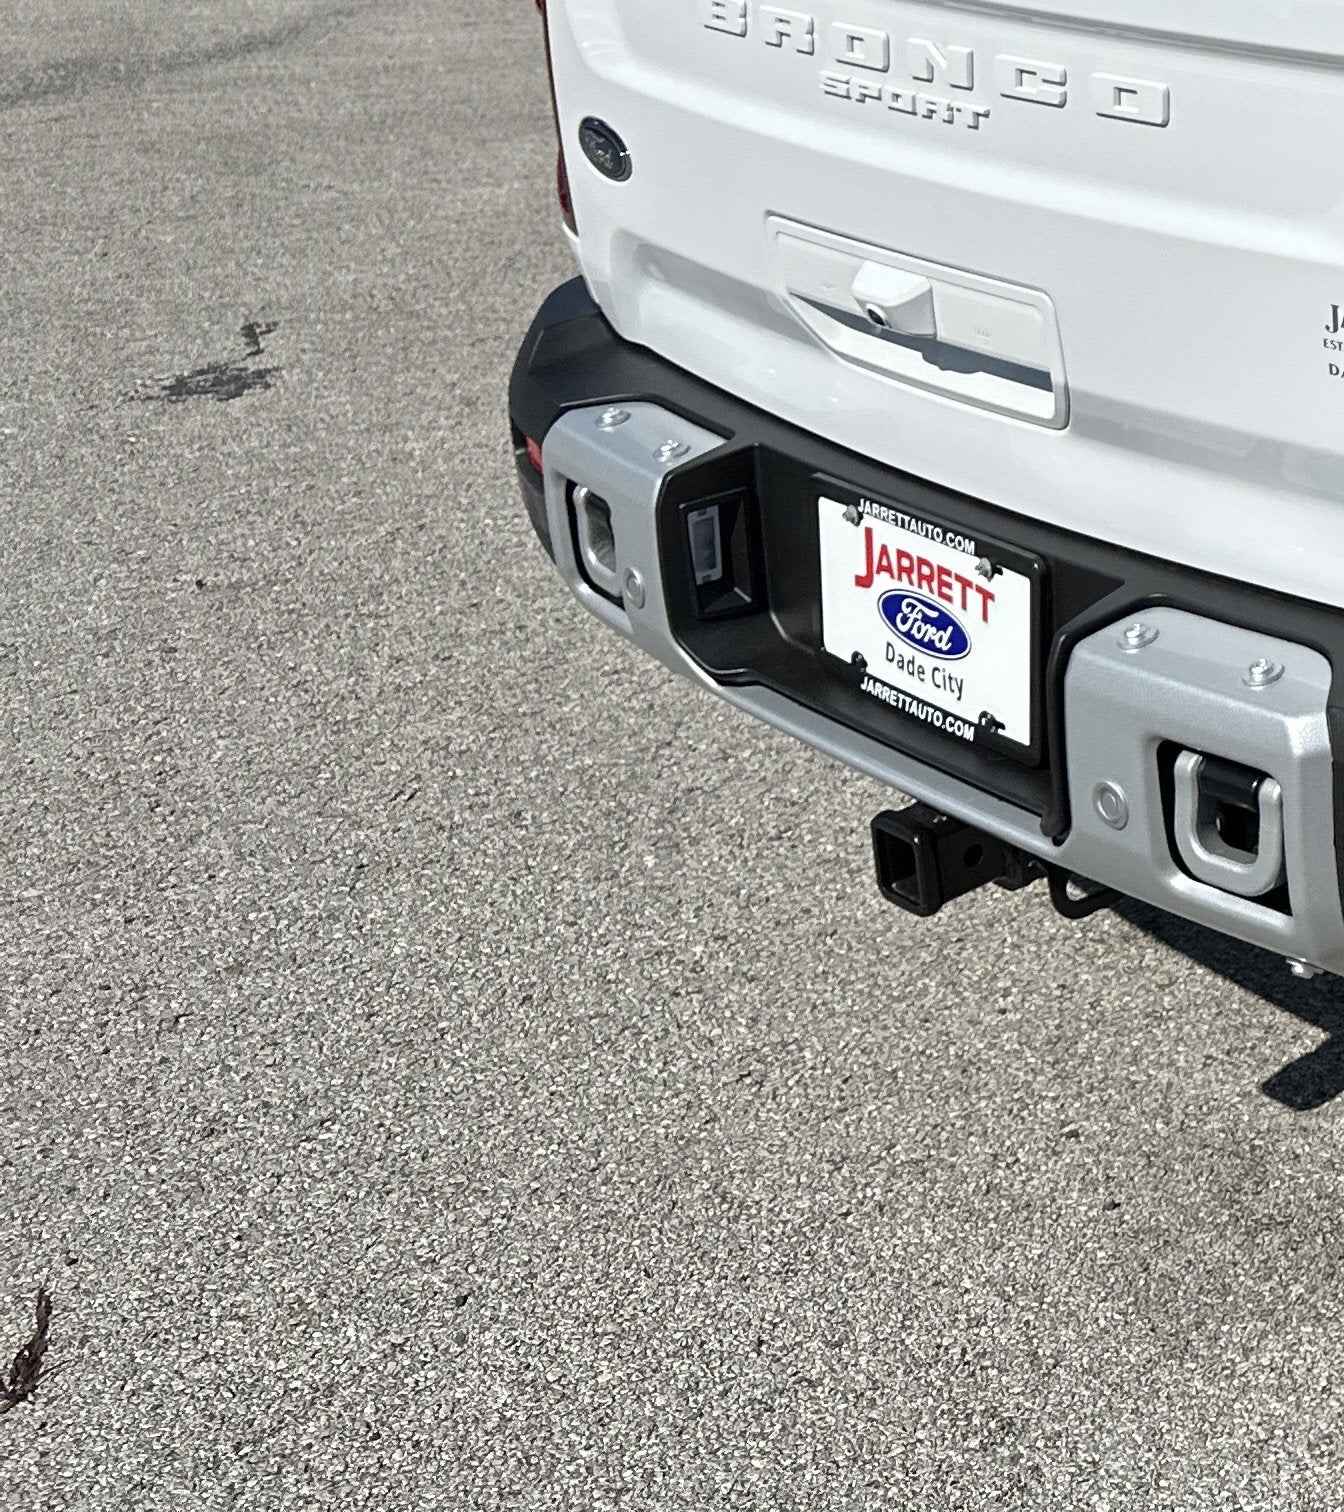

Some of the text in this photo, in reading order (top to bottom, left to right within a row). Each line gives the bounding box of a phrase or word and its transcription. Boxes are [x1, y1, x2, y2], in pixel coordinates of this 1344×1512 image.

[817, 70, 991, 131] SPORT
[857, 498, 976, 555] JARRETTAUTO.COM
[854, 526, 995, 624] JARRETT
[895, 597, 954, 651] Ford
[885, 641, 964, 701] Dade City
[860, 676, 976, 742] JARRETTAUTO.COM
